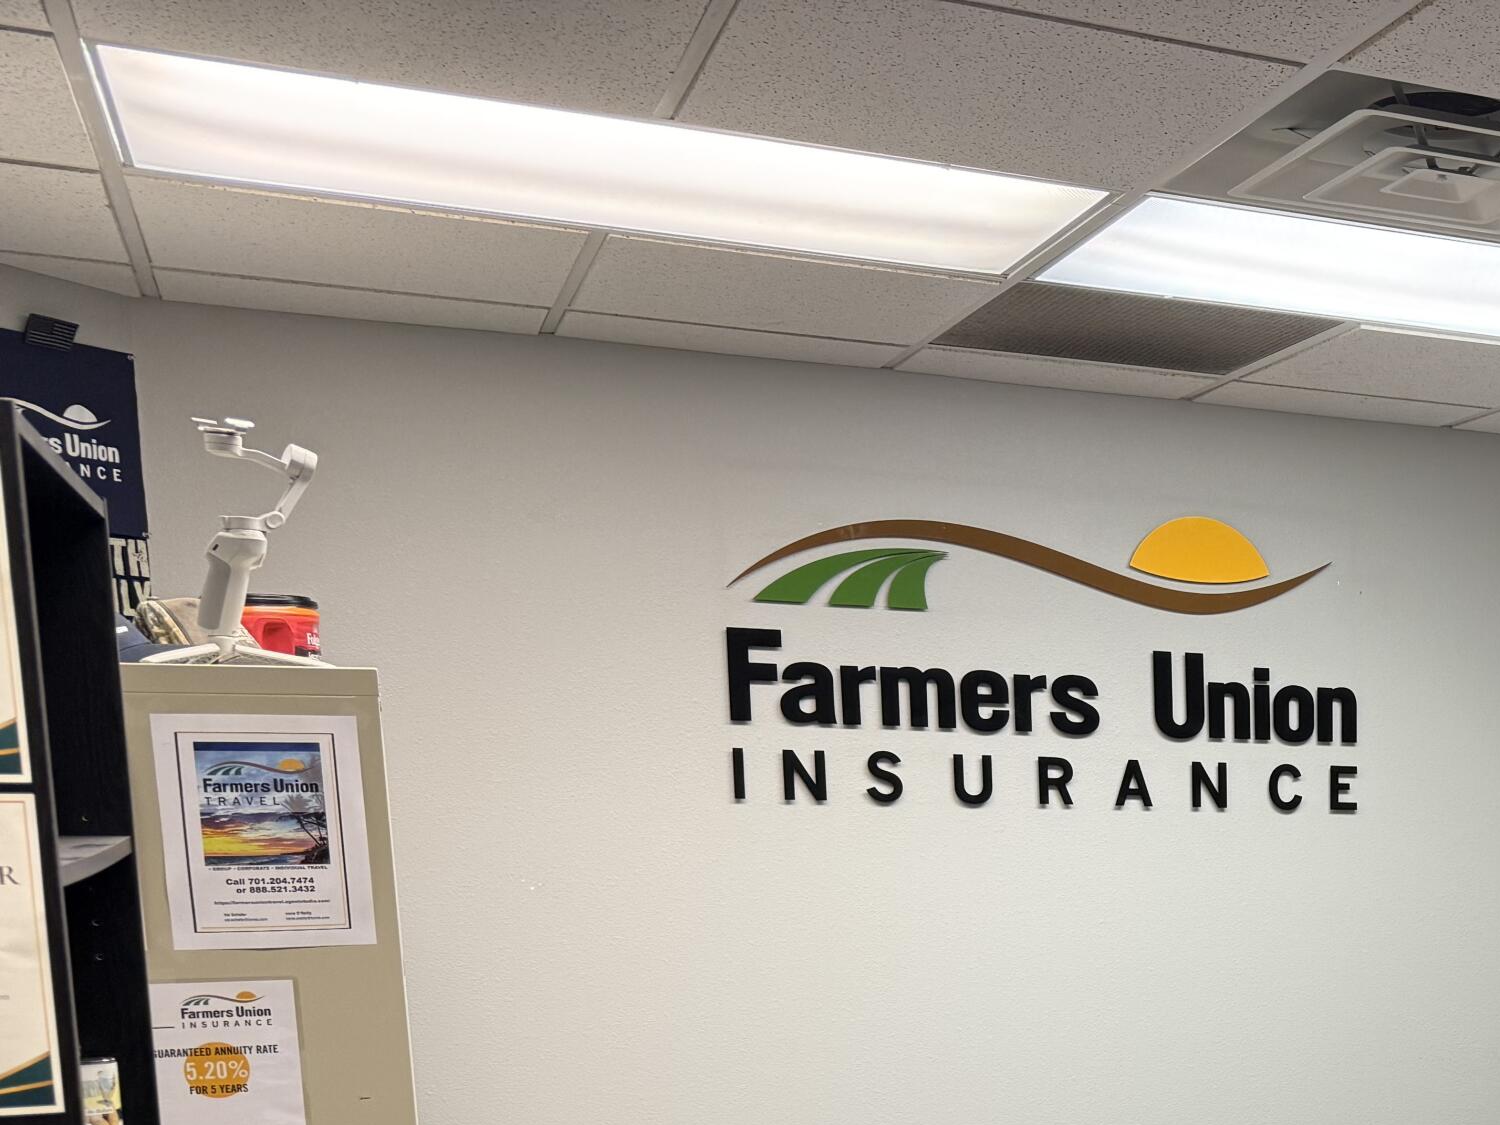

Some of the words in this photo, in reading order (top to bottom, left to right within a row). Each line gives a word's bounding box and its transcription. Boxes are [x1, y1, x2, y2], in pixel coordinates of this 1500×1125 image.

[64, 433, 120, 463] Union
[726, 626, 1100, 735] Farmers
[1152, 650, 1358, 743] Union
[203, 778, 270, 793] Farmers
[273, 778, 319, 793] Union
[732, 747, 1358, 811] INSURANCE
[205, 796, 280, 806] TRAVEL
[249, 877, 314, 885] 701.204.7474
[181, 1007, 234, 1019] Farmers
[236, 1006, 271, 1017] Union
[182, 1019, 272, 1029] INSURANCE
[153, 1047, 211, 1058] GUARANTEED
[214, 1046, 253, 1056] ANNUITY
[257, 1044, 279, 1054] RATE
[186, 1060, 248, 1081] 5.20%
[190, 1085, 208, 1094] FOR
[211, 1085, 216, 1093] 5
[220, 1083, 248, 1093] YEARS
